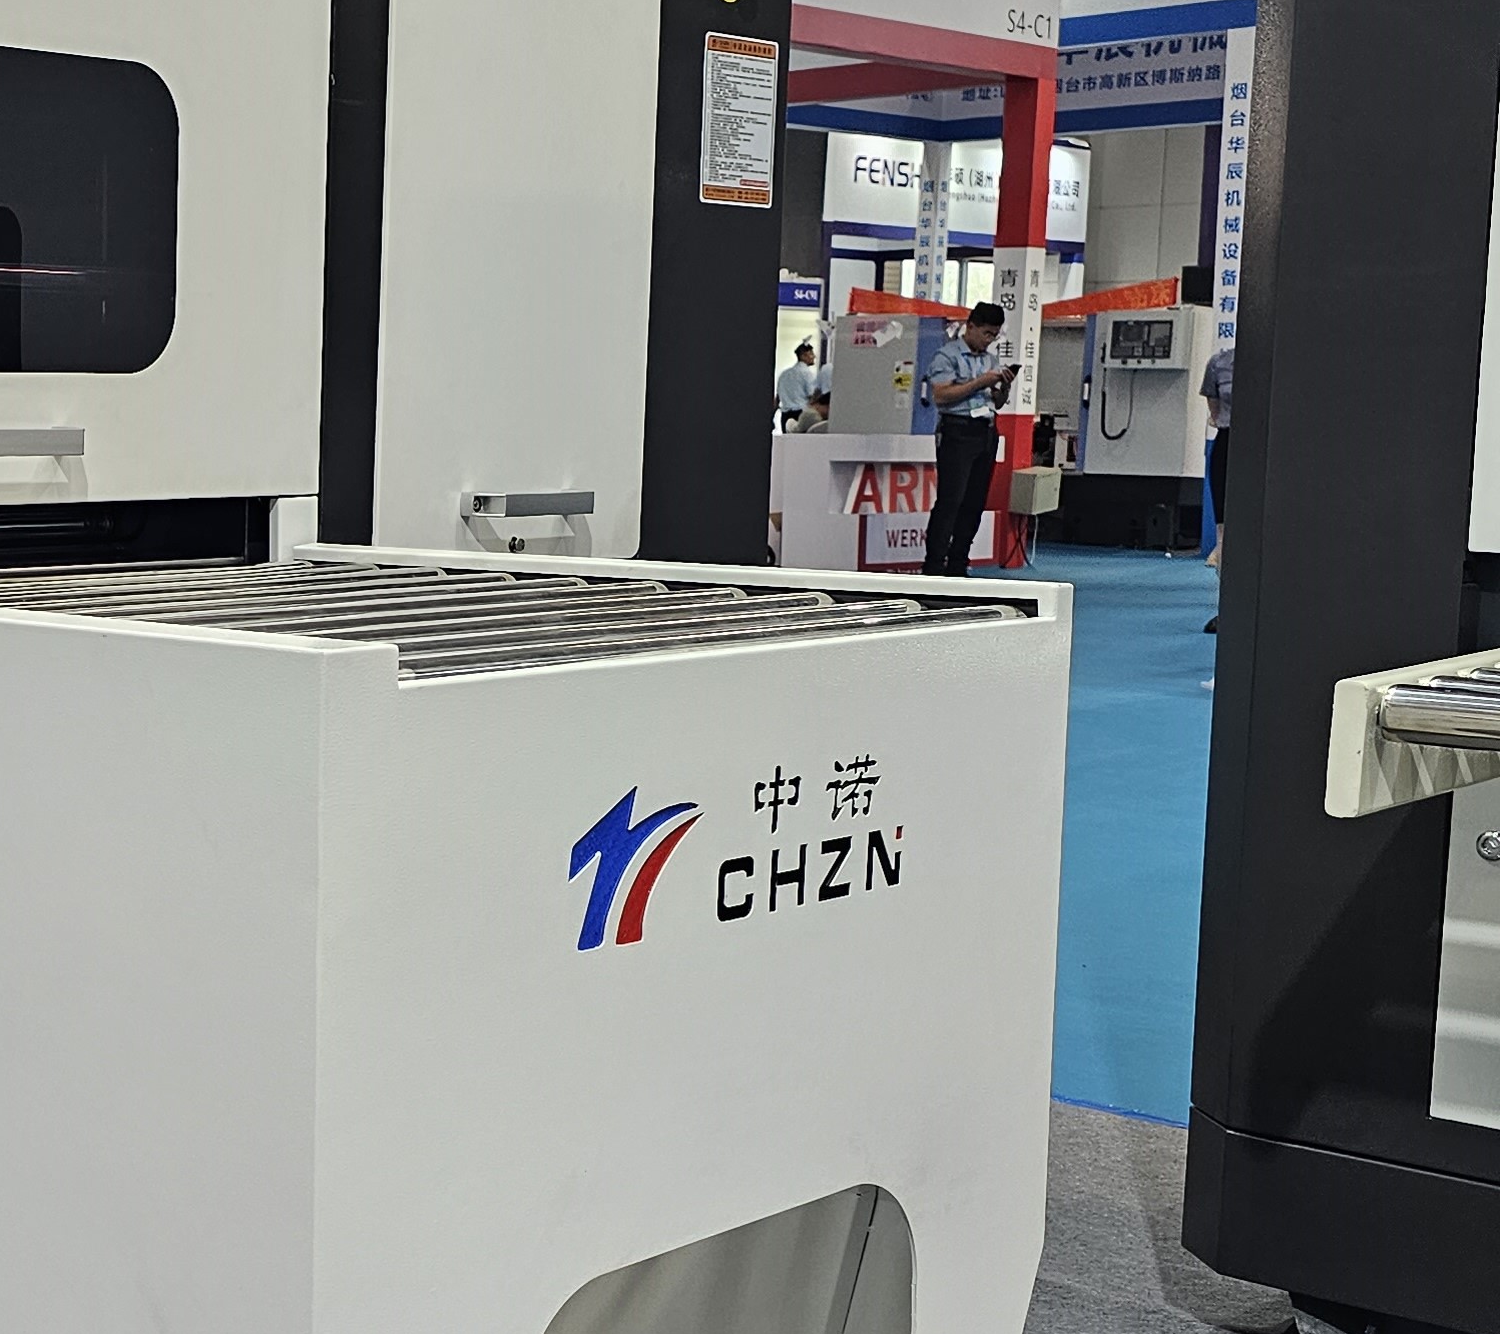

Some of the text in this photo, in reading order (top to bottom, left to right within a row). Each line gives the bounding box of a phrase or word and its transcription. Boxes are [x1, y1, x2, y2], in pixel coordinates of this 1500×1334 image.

[1007, 8, 1052, 39] S4-C1
[1217, 81, 1248, 356] 烟台华辰机械设备有限
[715, 824, 905, 923] CHZN
